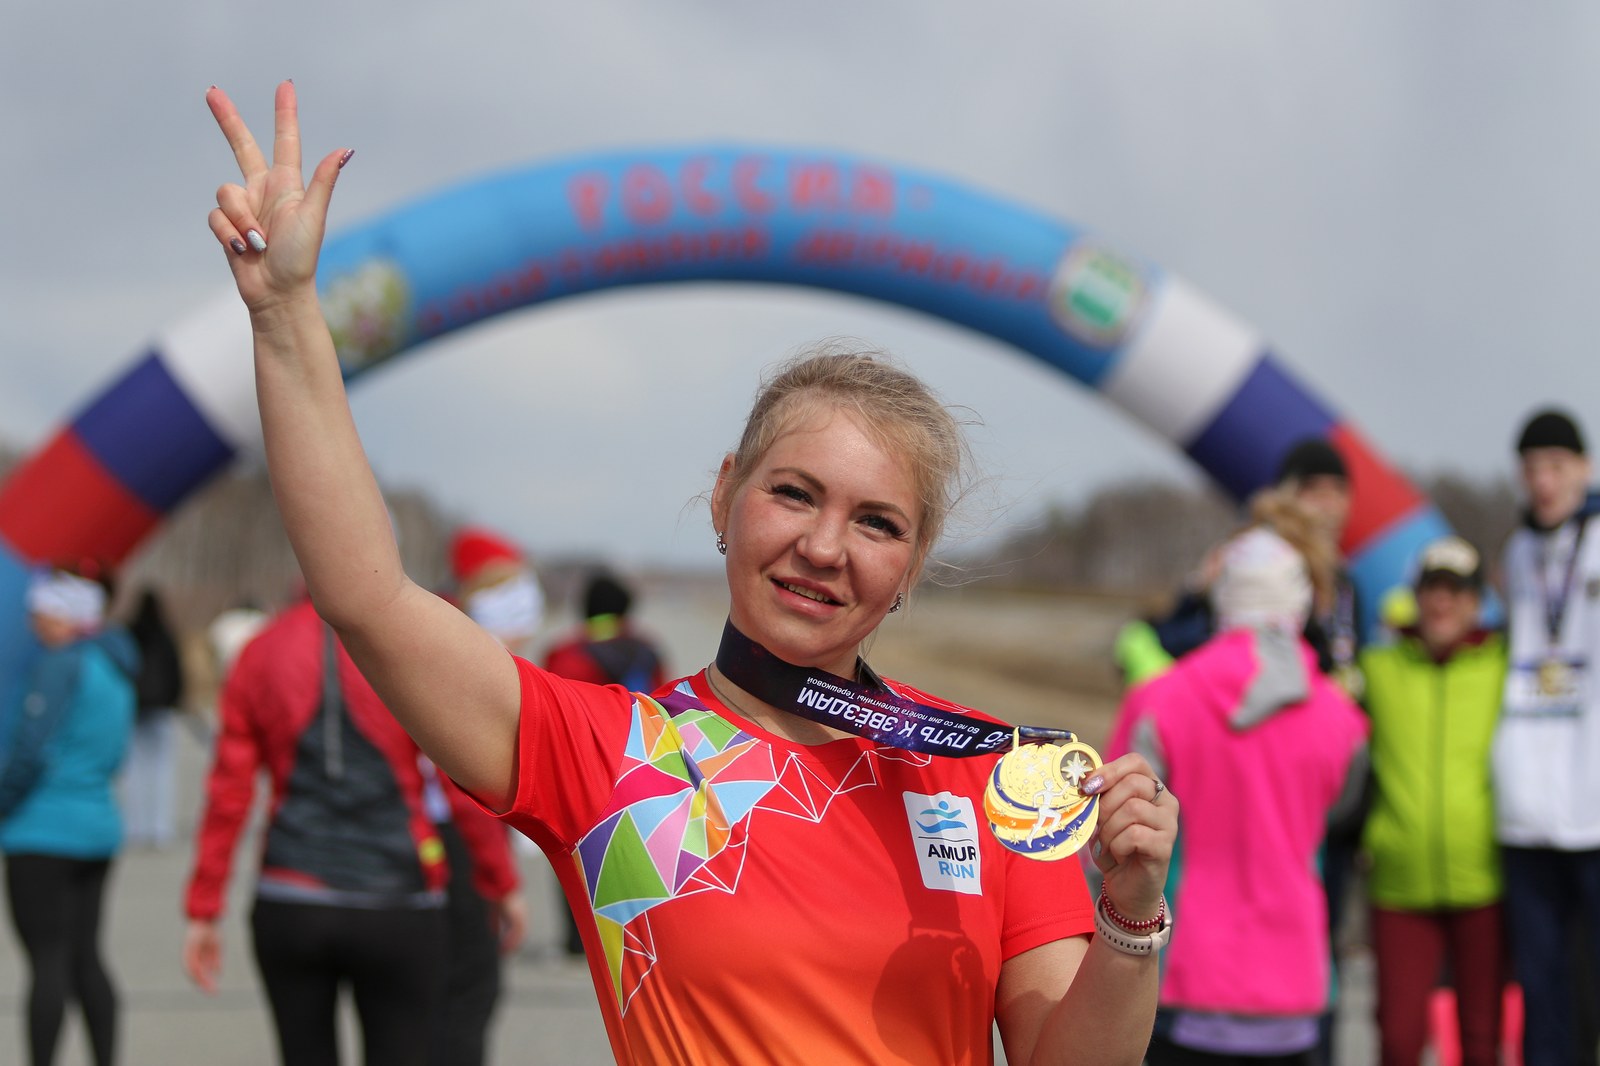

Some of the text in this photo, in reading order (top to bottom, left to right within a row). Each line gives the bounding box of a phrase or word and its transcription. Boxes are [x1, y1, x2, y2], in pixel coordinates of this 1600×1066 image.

[807, 677, 855, 699] Терешковой
[857, 694, 900, 713] Валентины
[797, 687, 972, 749] ПУТЬ К ЗВЁЗДАМ
[901, 708, 928, 721] полёта
[929, 716, 944, 724] дня
[954, 722, 967, 730] лет
[967, 726, 980, 734] 60
[928, 844, 977, 861] AMUR
[938, 861, 975, 878] RUN
